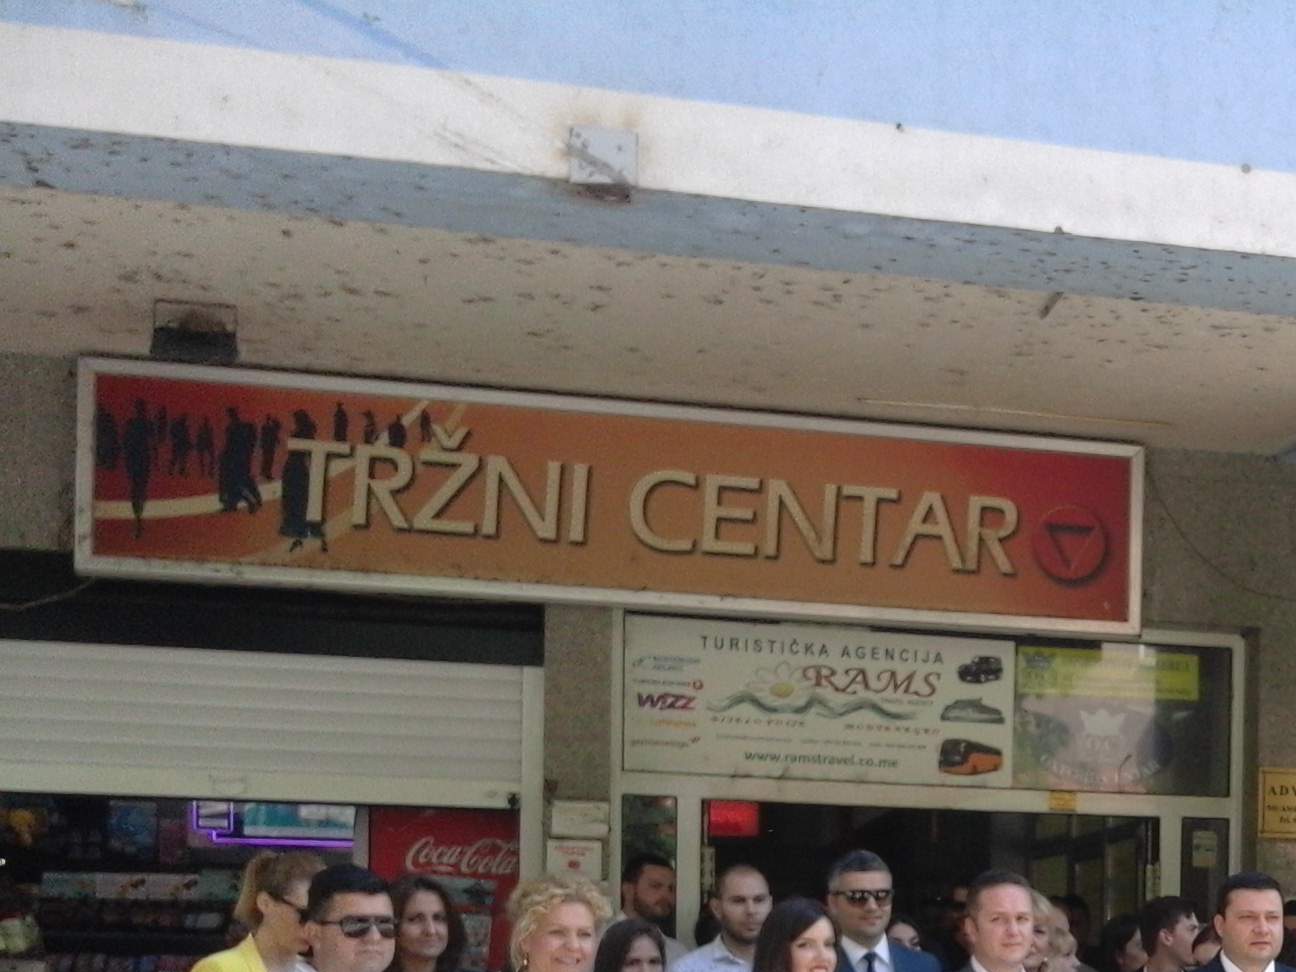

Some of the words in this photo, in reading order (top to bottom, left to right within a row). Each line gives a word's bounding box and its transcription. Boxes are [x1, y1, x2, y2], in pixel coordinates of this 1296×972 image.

[287, 424, 592, 544] TRŽNI
[629, 469, 1019, 576] CENTAR
[701, 635, 830, 657] TURISTIČKA
[841, 647, 945, 665] AGENCIJA
[803, 664, 942, 698] RAMS
[637, 691, 698, 711] WIZZ
[744, 751, 899, 769] www.ramstravel.co.me
